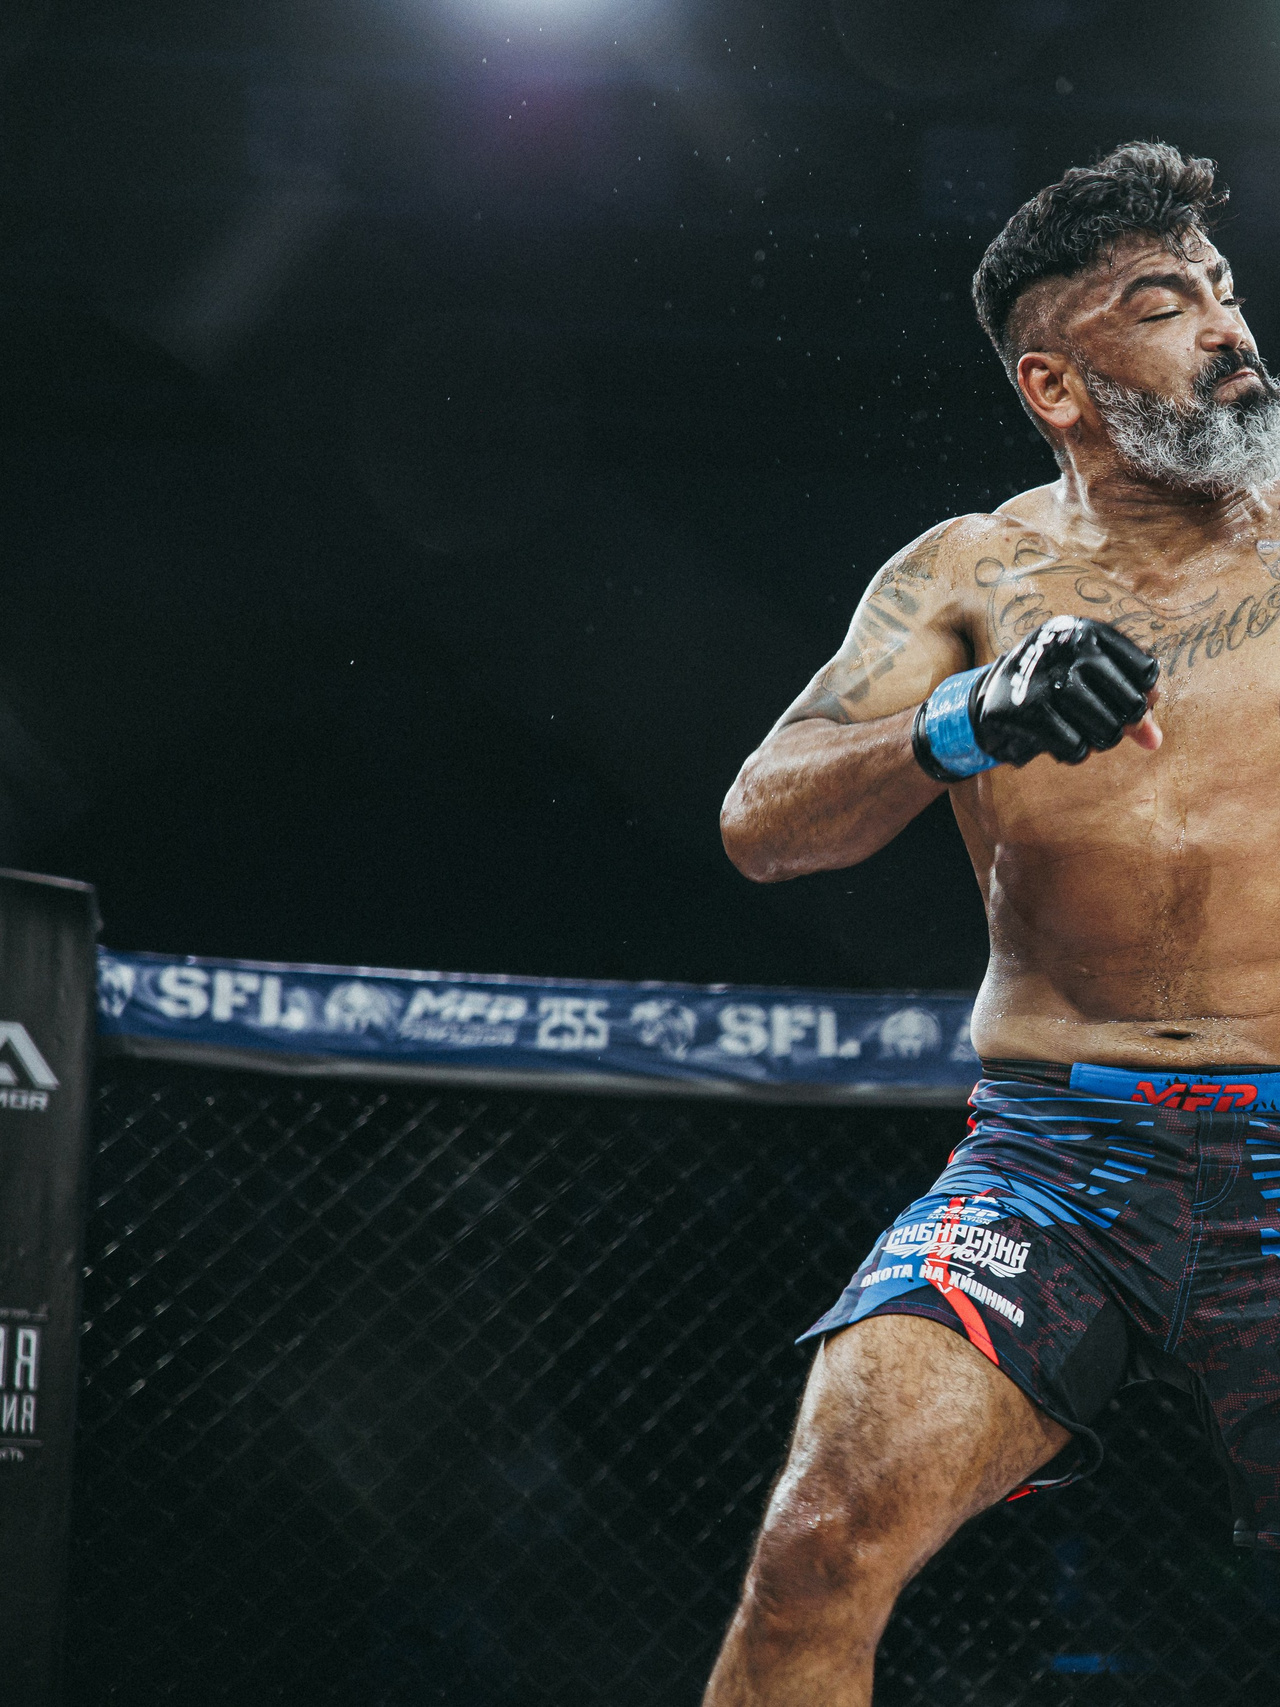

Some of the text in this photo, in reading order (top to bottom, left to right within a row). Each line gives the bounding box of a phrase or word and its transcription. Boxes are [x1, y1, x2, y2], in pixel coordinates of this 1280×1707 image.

[158, 966, 307, 1030] SFL
[537, 996, 610, 1050] 255
[718, 1004, 860, 1059] SFL
[1131, 1081, 1258, 1112] MFP
[932, 1205, 1000, 1218] MFP
[860, 1264, 1025, 1328] ОХОТА НА ХИЩНИКА
